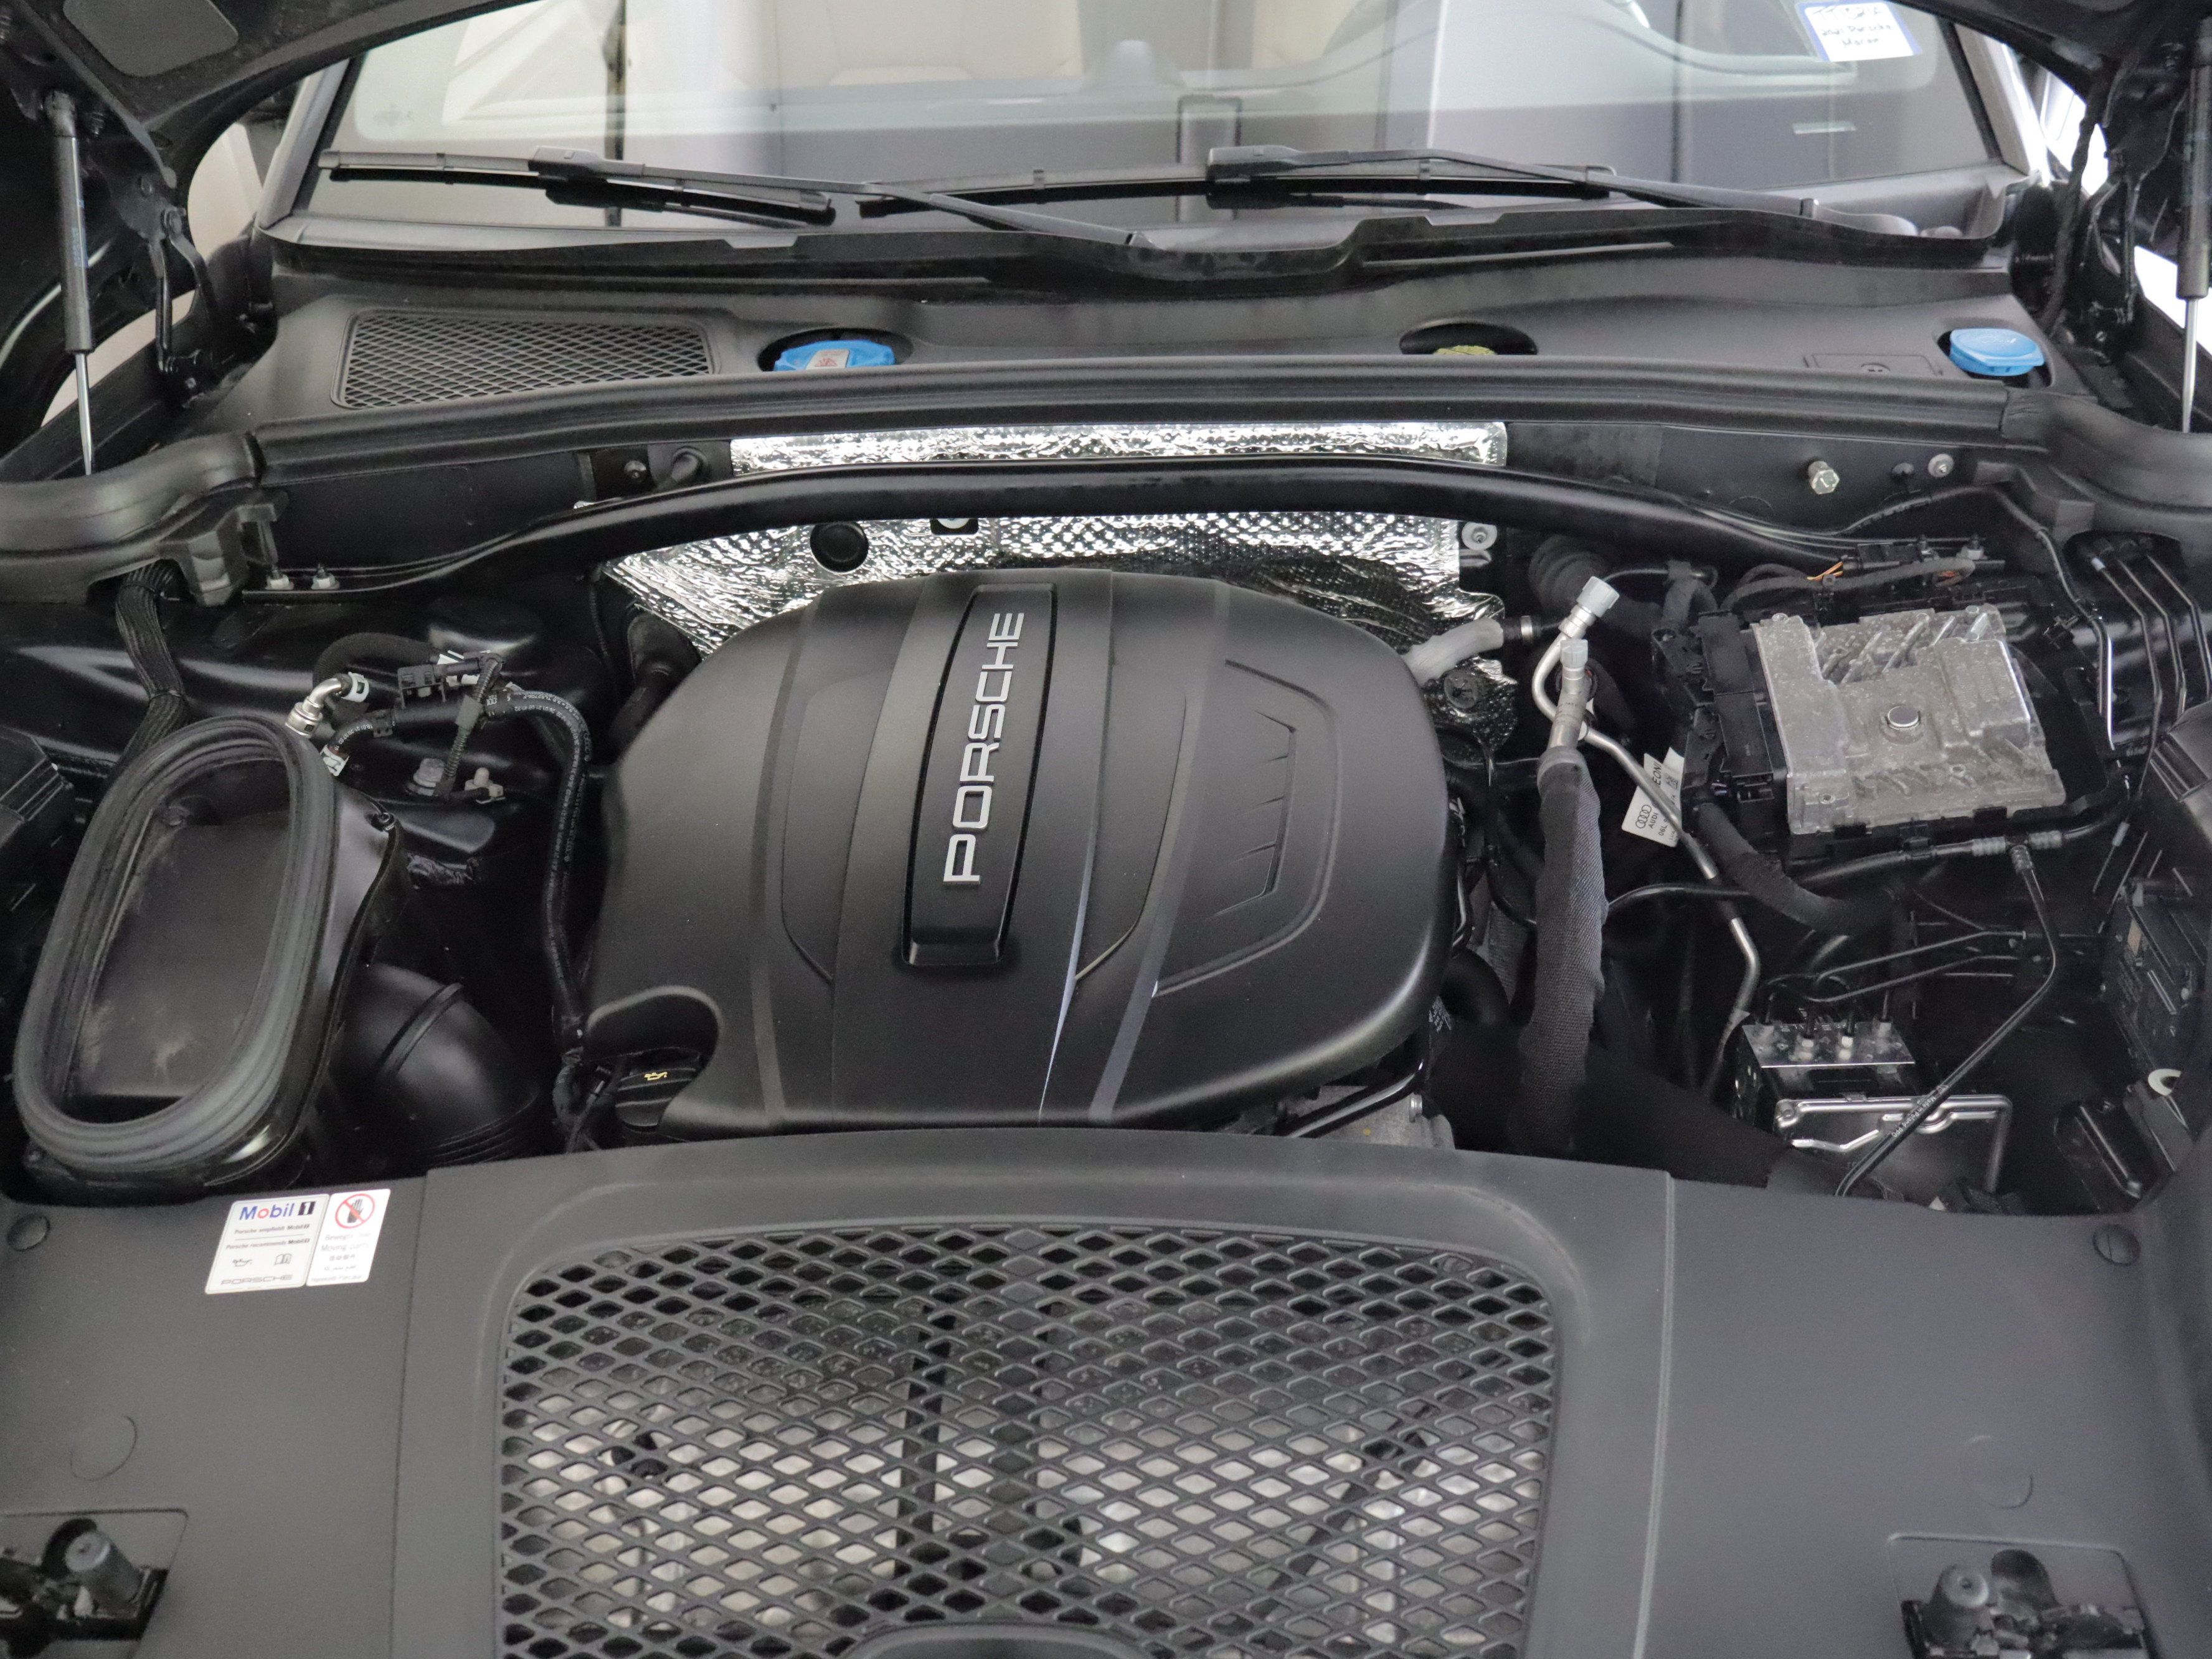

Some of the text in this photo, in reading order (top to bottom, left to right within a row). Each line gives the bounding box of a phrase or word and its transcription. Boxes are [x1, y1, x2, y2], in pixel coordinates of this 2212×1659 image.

[943, 613, 1024, 884] PORSCHE
[1652, 761, 1663, 787] EONI
[1648, 812, 1659, 829] AUDI
[1658, 824, 1668, 836] 06L
[239, 1203, 295, 1221] Mobil
[321, 1243, 347, 1252] Moving
[220, 1275, 293, 1285] PORSCHE
